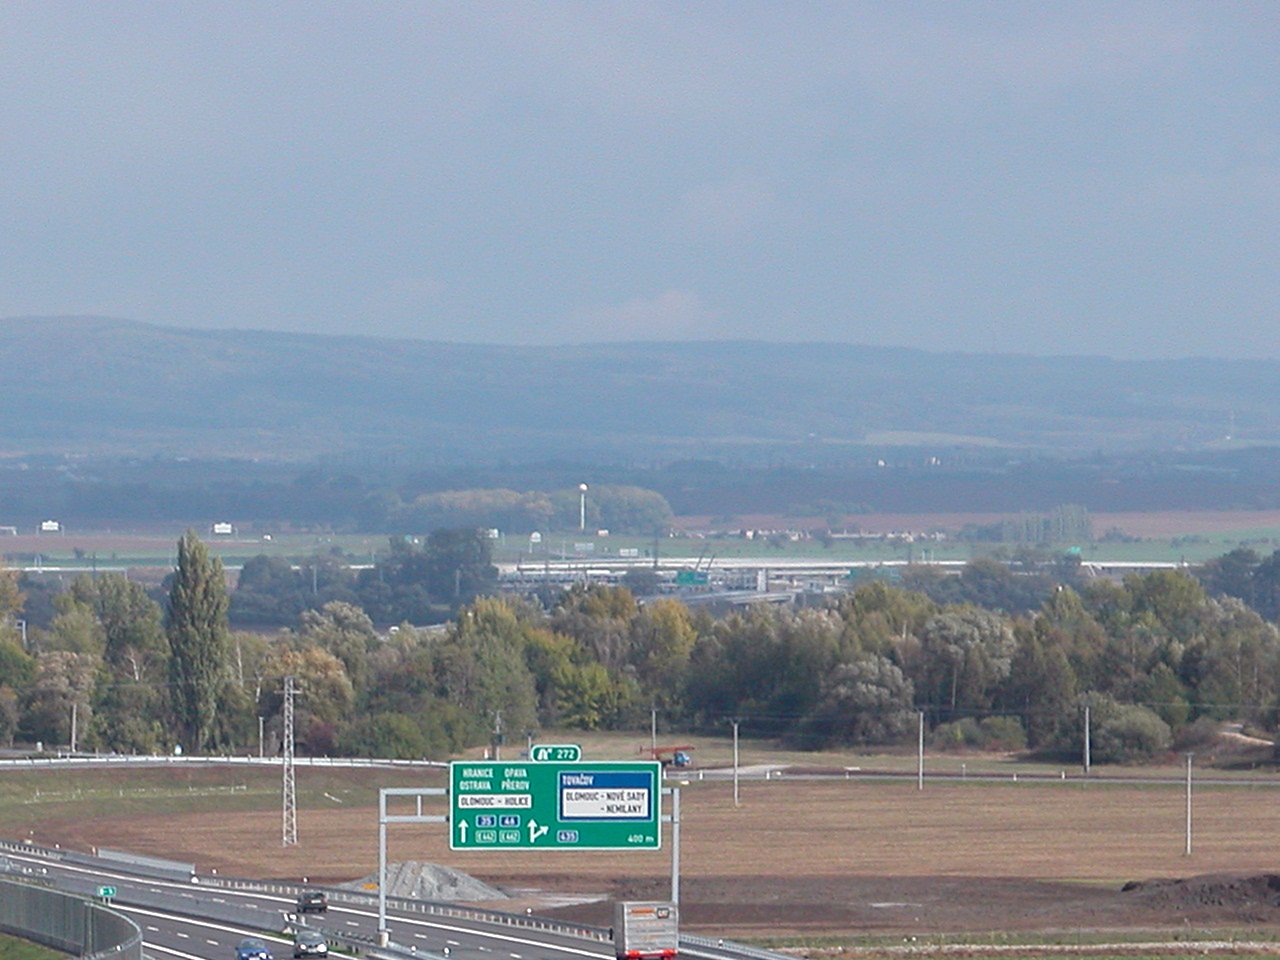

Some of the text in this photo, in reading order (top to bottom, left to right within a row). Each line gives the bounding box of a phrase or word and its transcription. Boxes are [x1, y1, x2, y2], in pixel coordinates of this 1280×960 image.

[557, 749, 574, 759] 272
[463, 768, 493, 778] HRANICE
[504, 768, 527, 777] OPAVA
[460, 781, 491, 790] OSTRAVA
[502, 778, 529, 790] PŘEROV
[566, 791, 599, 801] OLOMOUC
[606, 790, 624, 800] NOVÉ
[627, 791, 645, 800] SADY
[461, 796, 494, 806] OLOMOUC
[505, 796, 529, 806] HOLICE
[606, 804, 641, 813] NEMILANY
[628, 834, 644, 843] 400
